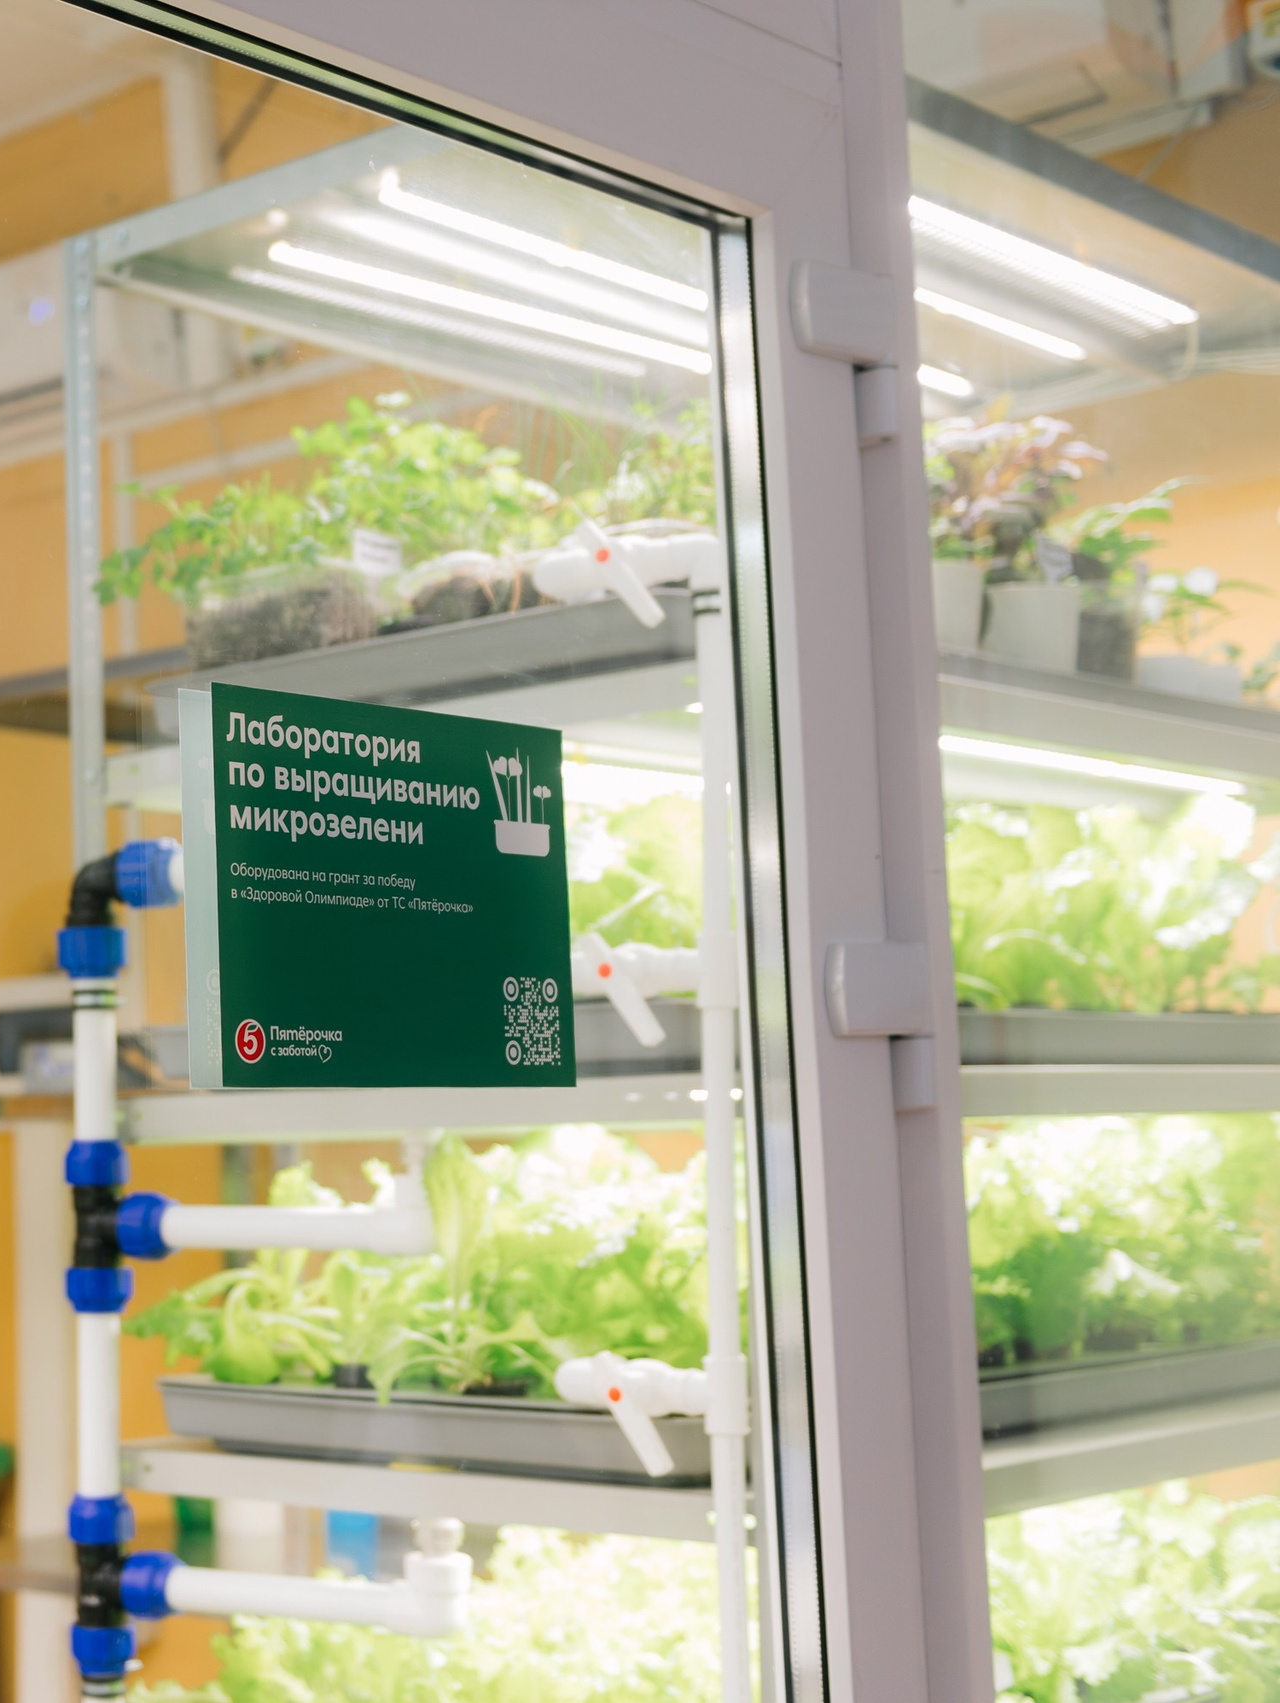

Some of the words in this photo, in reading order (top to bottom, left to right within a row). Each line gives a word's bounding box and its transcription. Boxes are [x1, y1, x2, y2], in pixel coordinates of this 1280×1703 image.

[226, 711, 421, 767] Лаборатория
[228, 761, 265, 788] по
[274, 766, 481, 811] выращиванию
[230, 804, 424, 845] микрозелени
[230, 862, 309, 881] Оборудована
[312, 871, 326, 882] на
[329, 873, 360, 886] грант
[363, 875, 375, 886] за
[378, 873, 416, 891] победу
[231, 888, 238, 899] в
[240, 886, 302, 904] «Здоровой
[305, 890, 375, 909] Олимпиаде»
[377, 898, 389, 909] от
[392, 896, 406, 909] ТС
[408, 897, 474, 915] «Пятёрочка»
[270, 1025, 343, 1045] Пятёрочка
[270, 1046, 276, 1056] с
[278, 1044, 318, 1056] заботой
